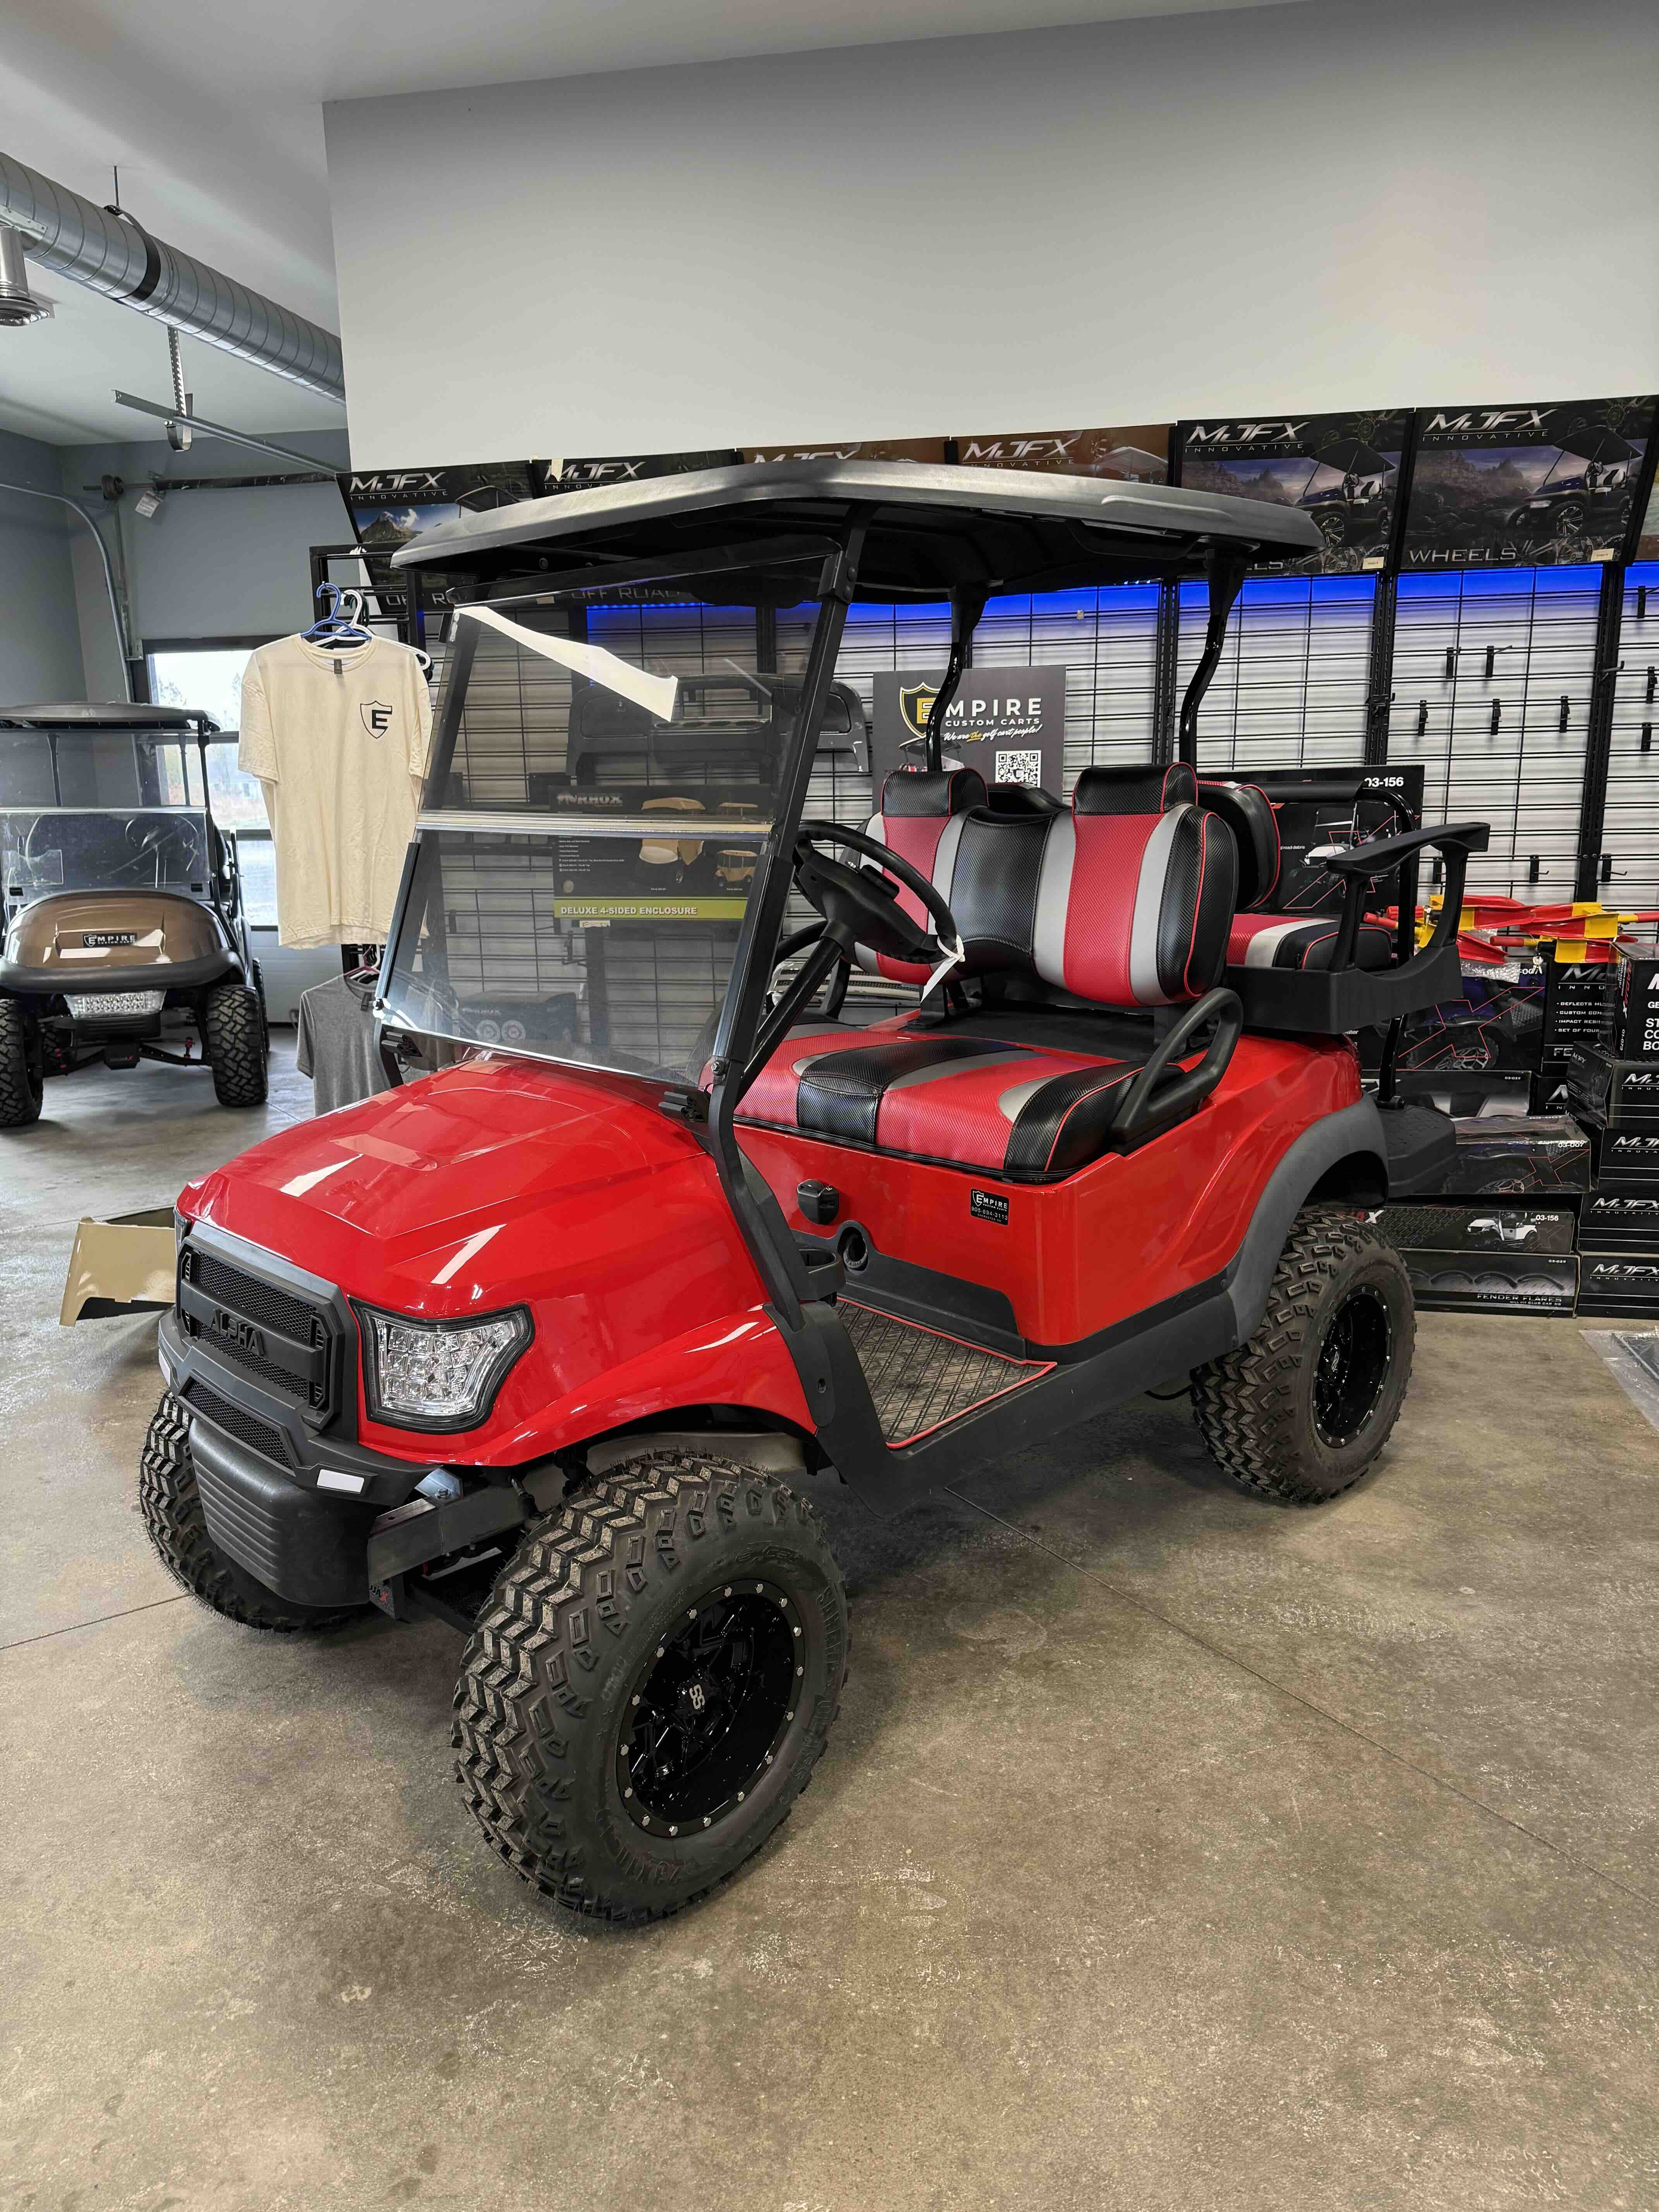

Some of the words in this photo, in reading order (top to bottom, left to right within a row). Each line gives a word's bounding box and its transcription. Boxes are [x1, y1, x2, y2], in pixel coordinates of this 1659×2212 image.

[1424, 409, 1558, 433] MJFX
[1186, 421, 1310, 444] MJFX
[1422, 431, 1548, 442] INNOVATIVE
[962, 438, 1079, 460] MJFX
[1185, 443, 1304, 453] INNOVATIVE
[971, 460, 1074, 468] NOVATIVE
[349, 472, 446, 493] MJFX
[350, 491, 448, 501] INNOVATIVE
[1410, 548, 1516, 563] WHEELS
[944, 732, 957, 741] We
[980, 728, 999, 741] golf
[997, 728, 1015, 736] cart
[1011, 724, 1042, 738] people!
[976, 1194, 1008, 1209] EMPIRE
[211, 1307, 264, 1356] ALPHA
